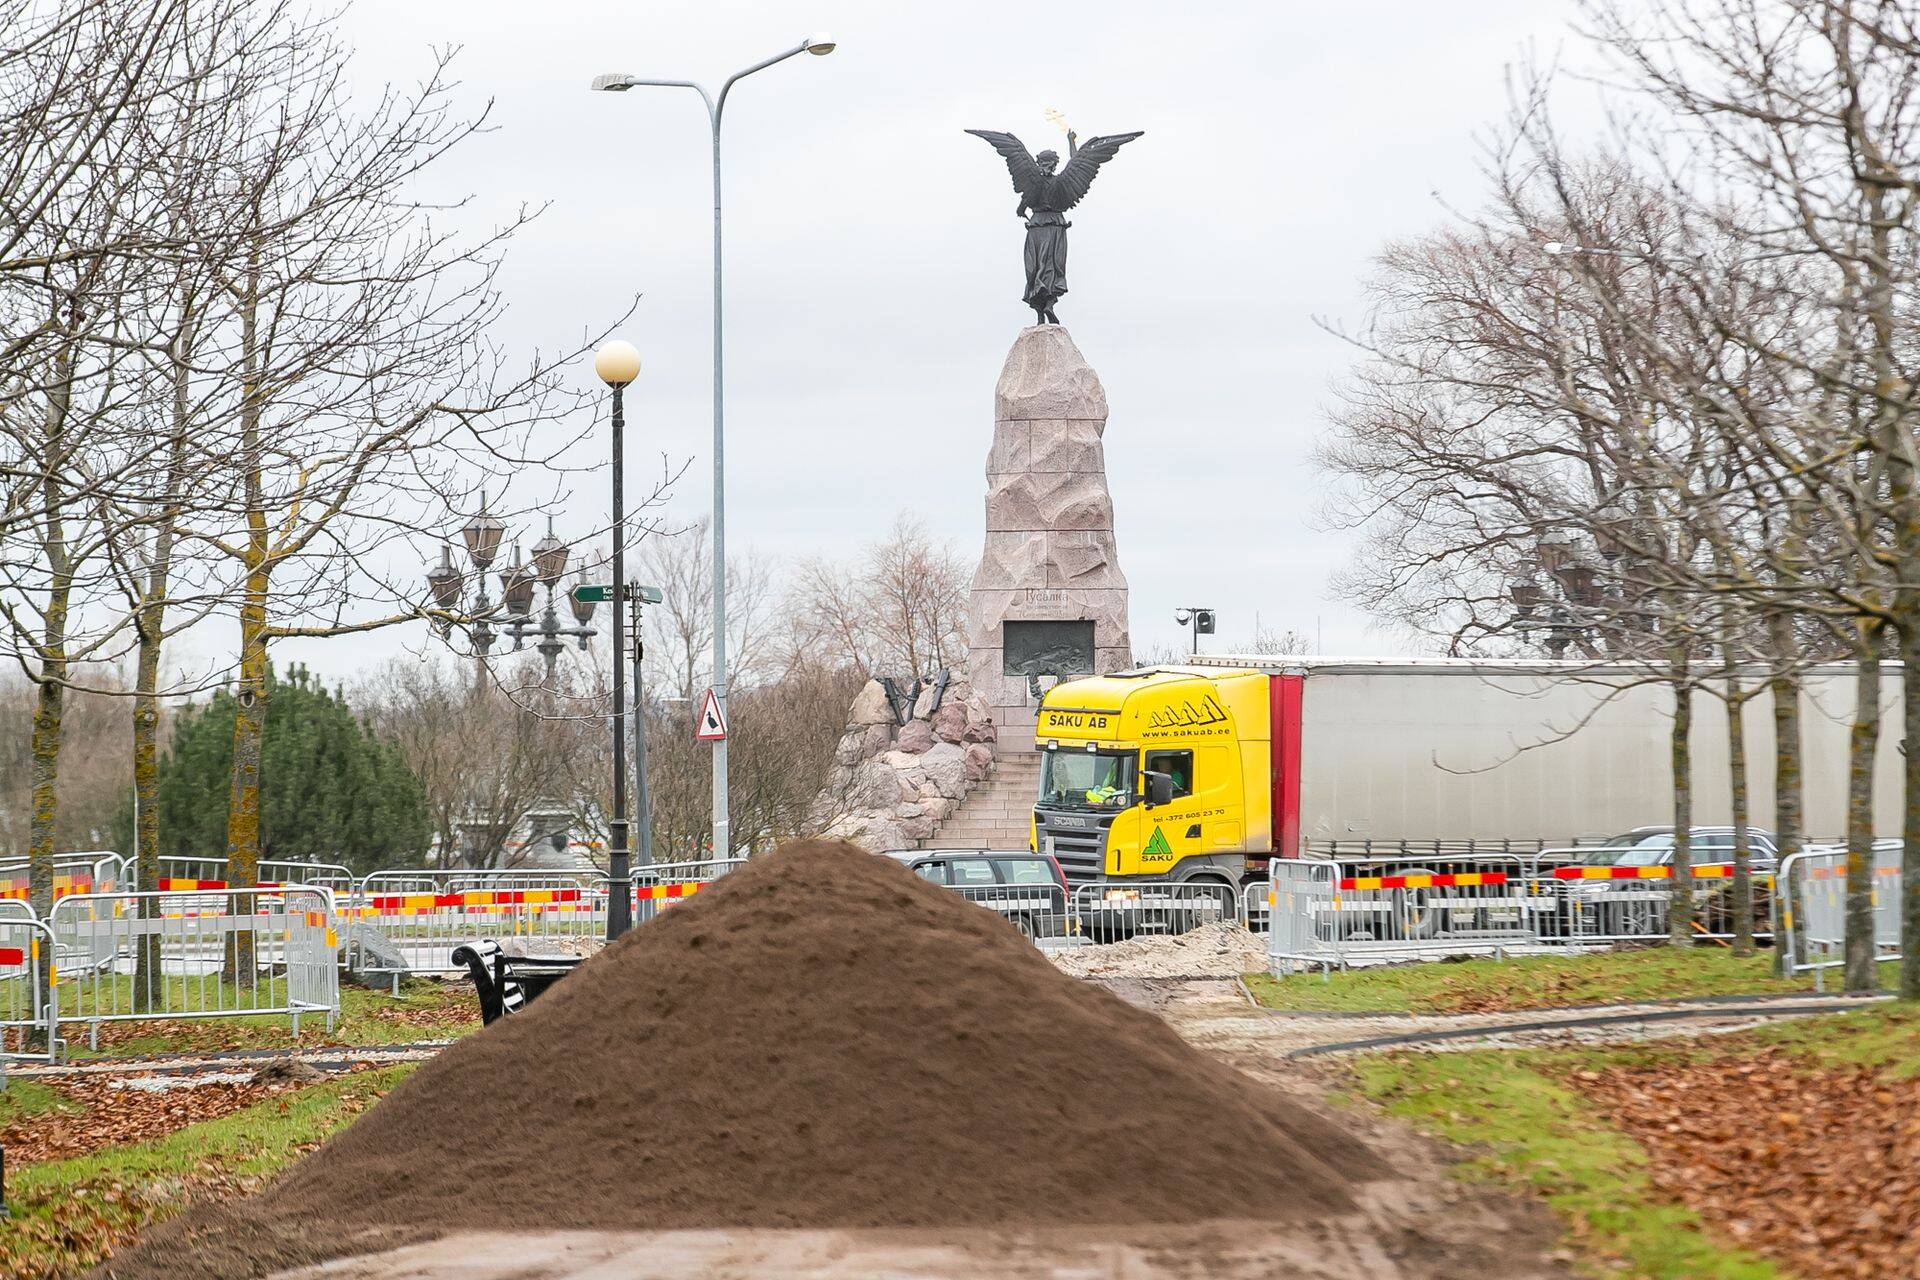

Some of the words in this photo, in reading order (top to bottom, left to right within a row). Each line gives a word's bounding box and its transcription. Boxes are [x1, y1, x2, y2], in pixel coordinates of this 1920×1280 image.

[1049, 714, 1083, 727] SAKU
[1089, 716, 1107, 728] AB
[1142, 728, 1230, 738] www.sakuab.ee
[1054, 816, 1086, 827] SCANIA
